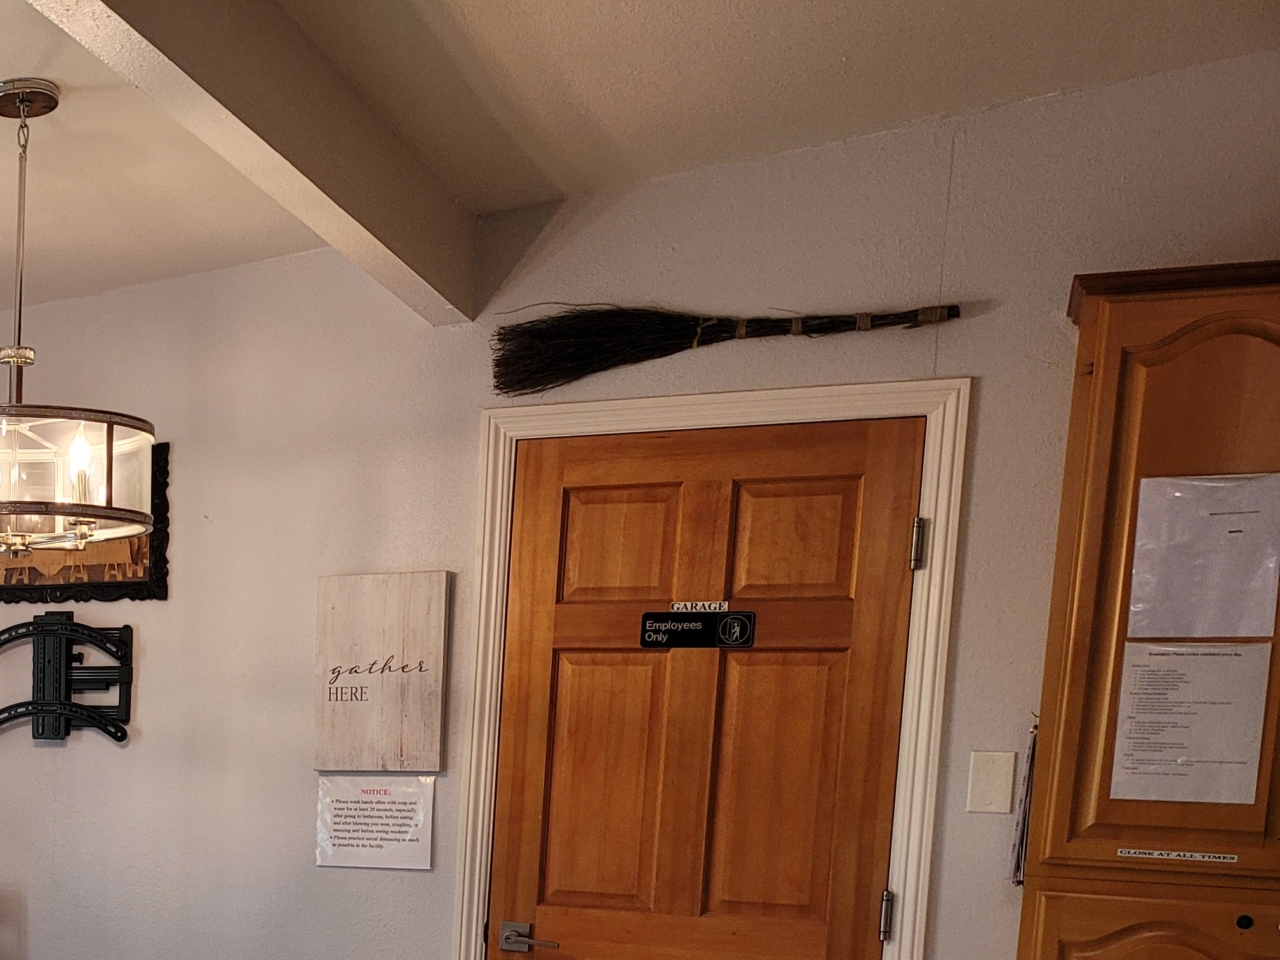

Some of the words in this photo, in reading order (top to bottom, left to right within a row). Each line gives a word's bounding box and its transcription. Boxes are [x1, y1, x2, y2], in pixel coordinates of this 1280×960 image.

[671, 602, 727, 611] GARAGE
[646, 620, 702, 632] Employees
[645, 632, 668, 643] Only
[329, 655, 429, 685] gather
[328, 686, 369, 701] HERE
[360, 788, 391, 796] NOTICE:
[1119, 849, 1155, 857] CLOSE
